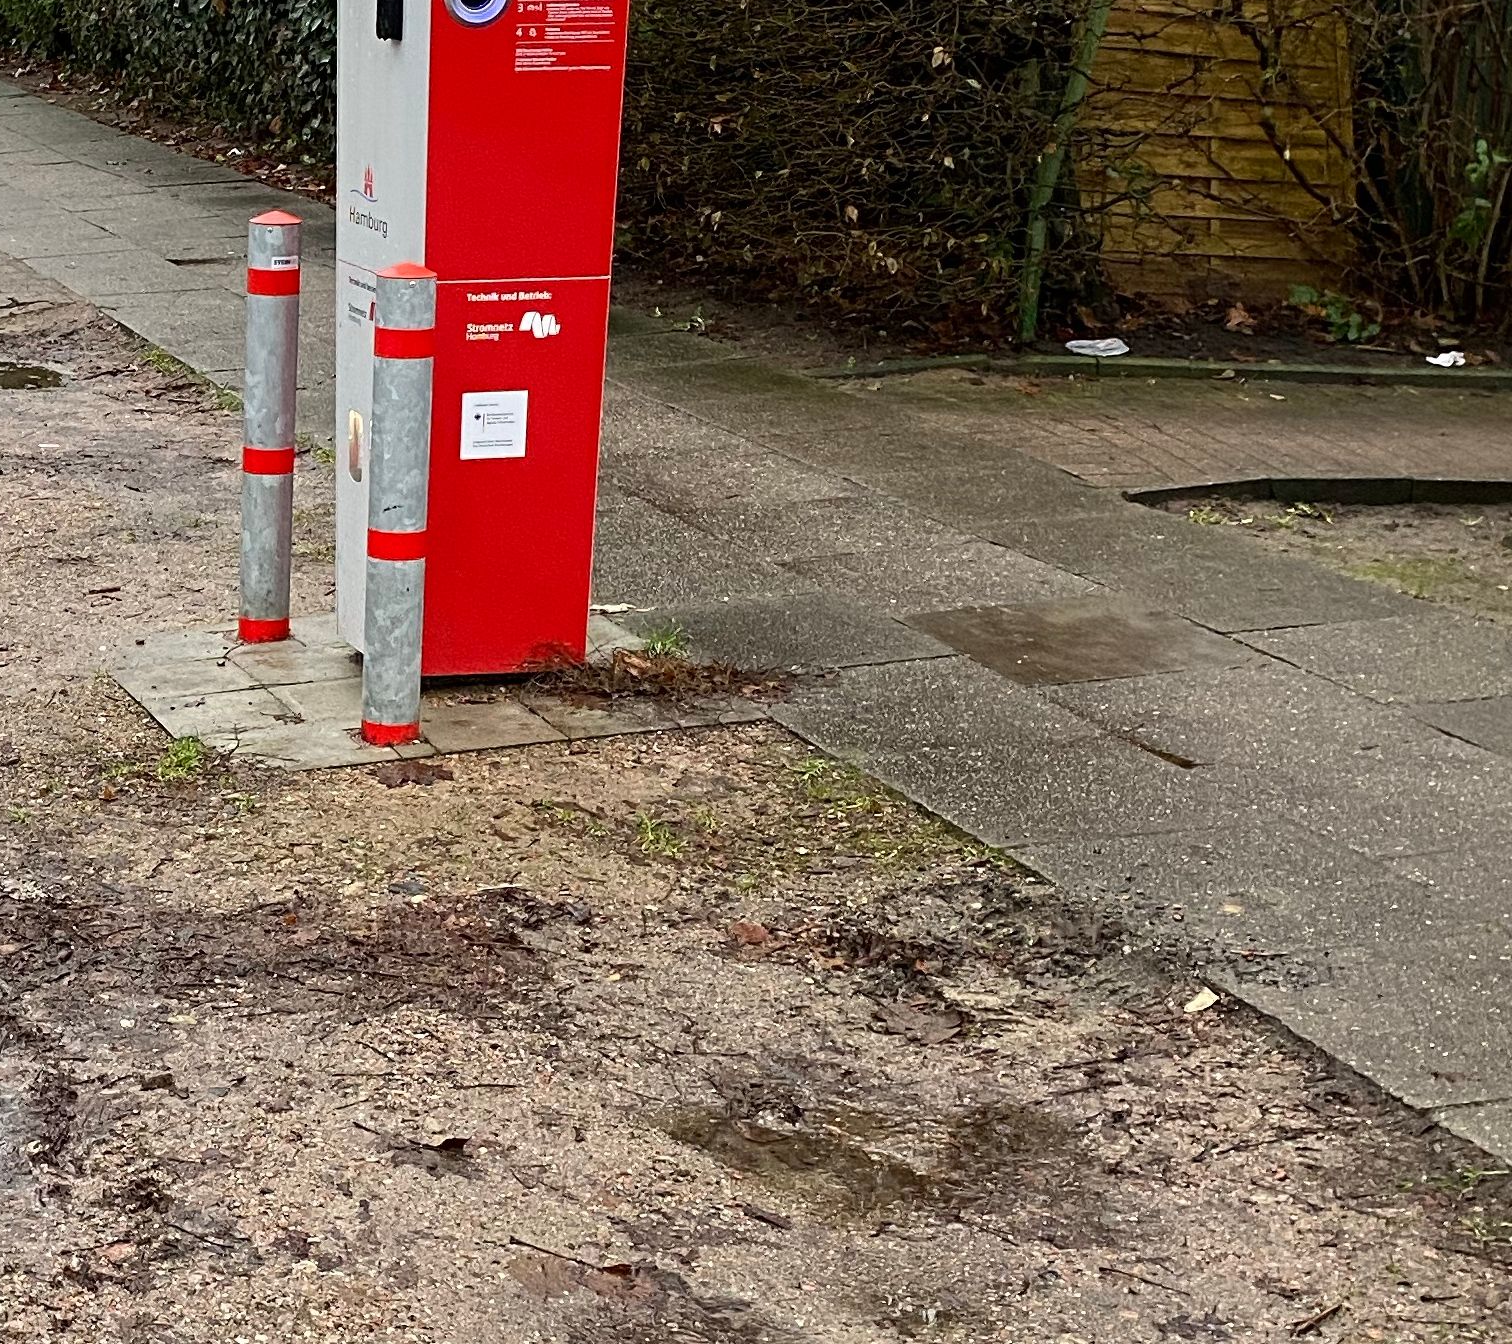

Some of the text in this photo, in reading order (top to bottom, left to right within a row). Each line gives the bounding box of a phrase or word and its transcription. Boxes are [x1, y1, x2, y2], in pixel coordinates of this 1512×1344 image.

[349, 205, 388, 239] Hamburg
[466, 292, 500, 302] Technik
[500, 291, 518, 301] und
[466, 323, 514, 333] Stromnetz
